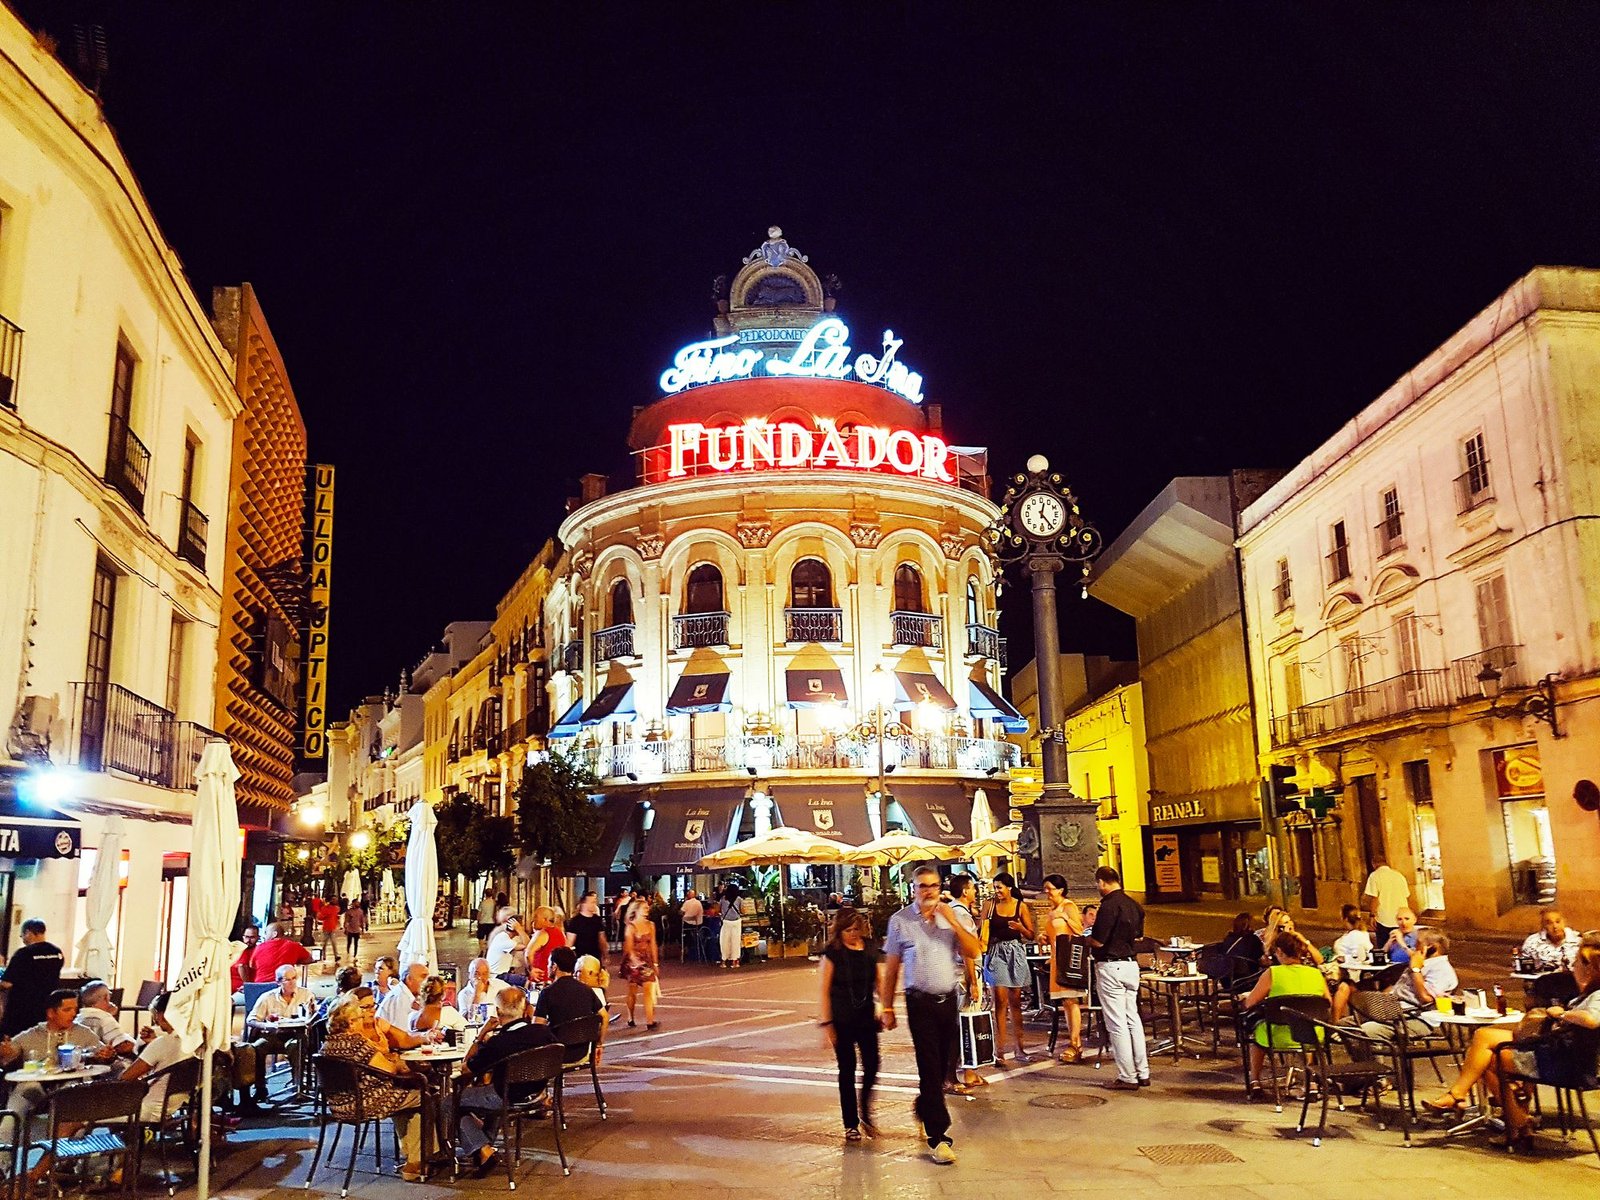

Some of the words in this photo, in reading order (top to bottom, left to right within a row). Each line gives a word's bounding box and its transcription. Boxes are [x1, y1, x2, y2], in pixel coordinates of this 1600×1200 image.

[660, 334, 764, 393] Fino
[765, 317, 852, 378] La
[740, 330, 773, 341] PEDRO
[773, 329, 808, 340] DOMEC
[668, 421, 954, 482] FUNDADOR
[315, 469, 333, 588] ULLOA
[1153, 800, 1206, 821] RIANAL
